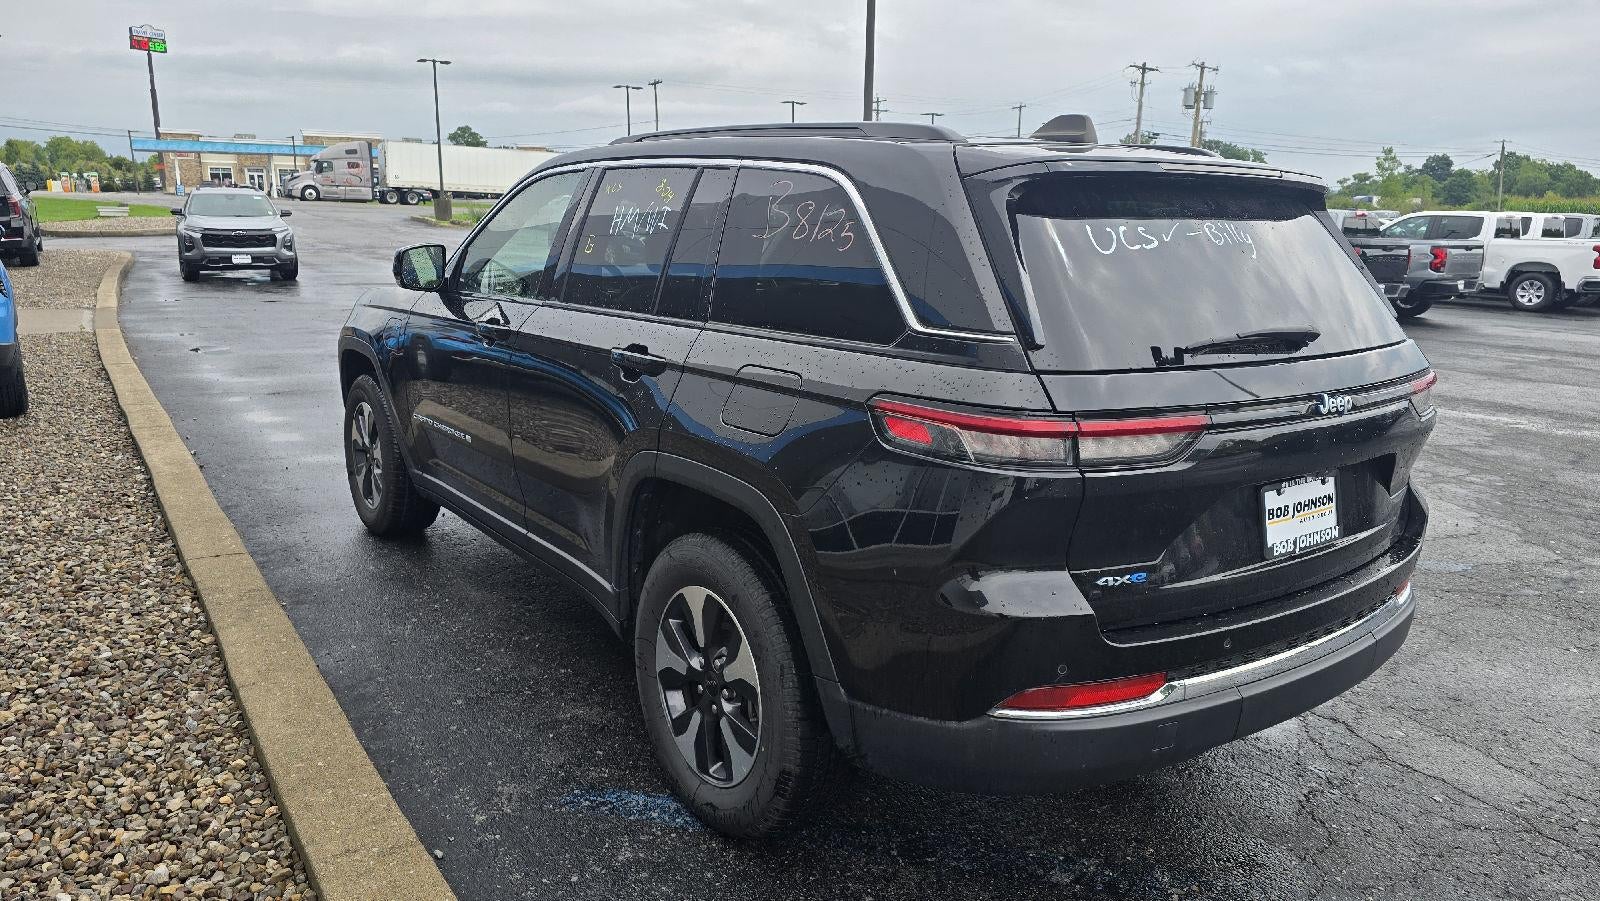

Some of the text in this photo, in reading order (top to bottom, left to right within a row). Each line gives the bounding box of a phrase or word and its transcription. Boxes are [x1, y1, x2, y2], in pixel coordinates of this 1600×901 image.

[1318, 393, 1353, 415] Jeep
[1267, 493, 1334, 521] BOB JOHNSON
[1273, 525, 1339, 556] BOB JOHNSON
